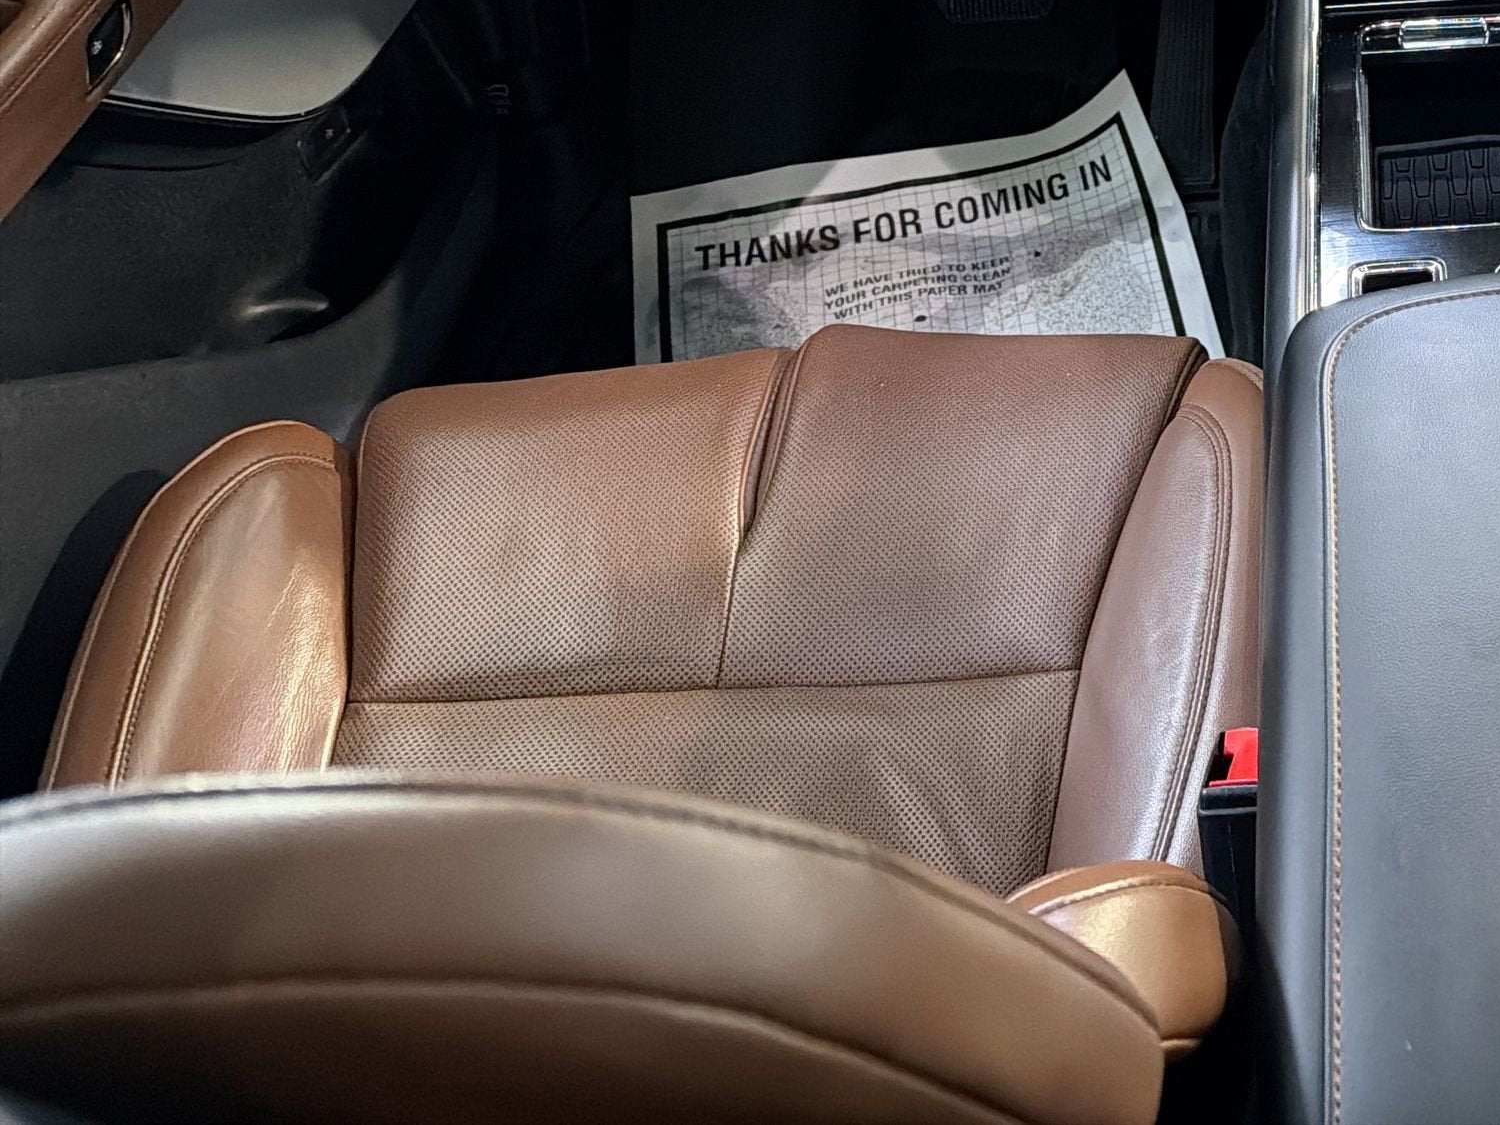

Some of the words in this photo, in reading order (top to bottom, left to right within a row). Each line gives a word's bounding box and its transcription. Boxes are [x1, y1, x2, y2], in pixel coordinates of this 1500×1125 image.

[694, 225, 841, 271] THANKS
[853, 208, 922, 244] FOR
[934, 172, 1070, 230] COMING
[1079, 155, 1113, 191] IN
[824, 290, 868, 310] YOUR
[871, 273, 958, 297] CARPETING
[962, 266, 1012, 283] CLEAN
[825, 283, 849, 298] WE
[853, 273, 893, 290] HAVE
[899, 264, 942, 279] TRIED
[948, 262, 966, 273] TO
[971, 255, 1011, 271] KEEP
[833, 300, 874, 321] WITH
[880, 291, 914, 308] THIS
[917, 283, 968, 298] PAPER
[972, 280, 1005, 295] MAT
